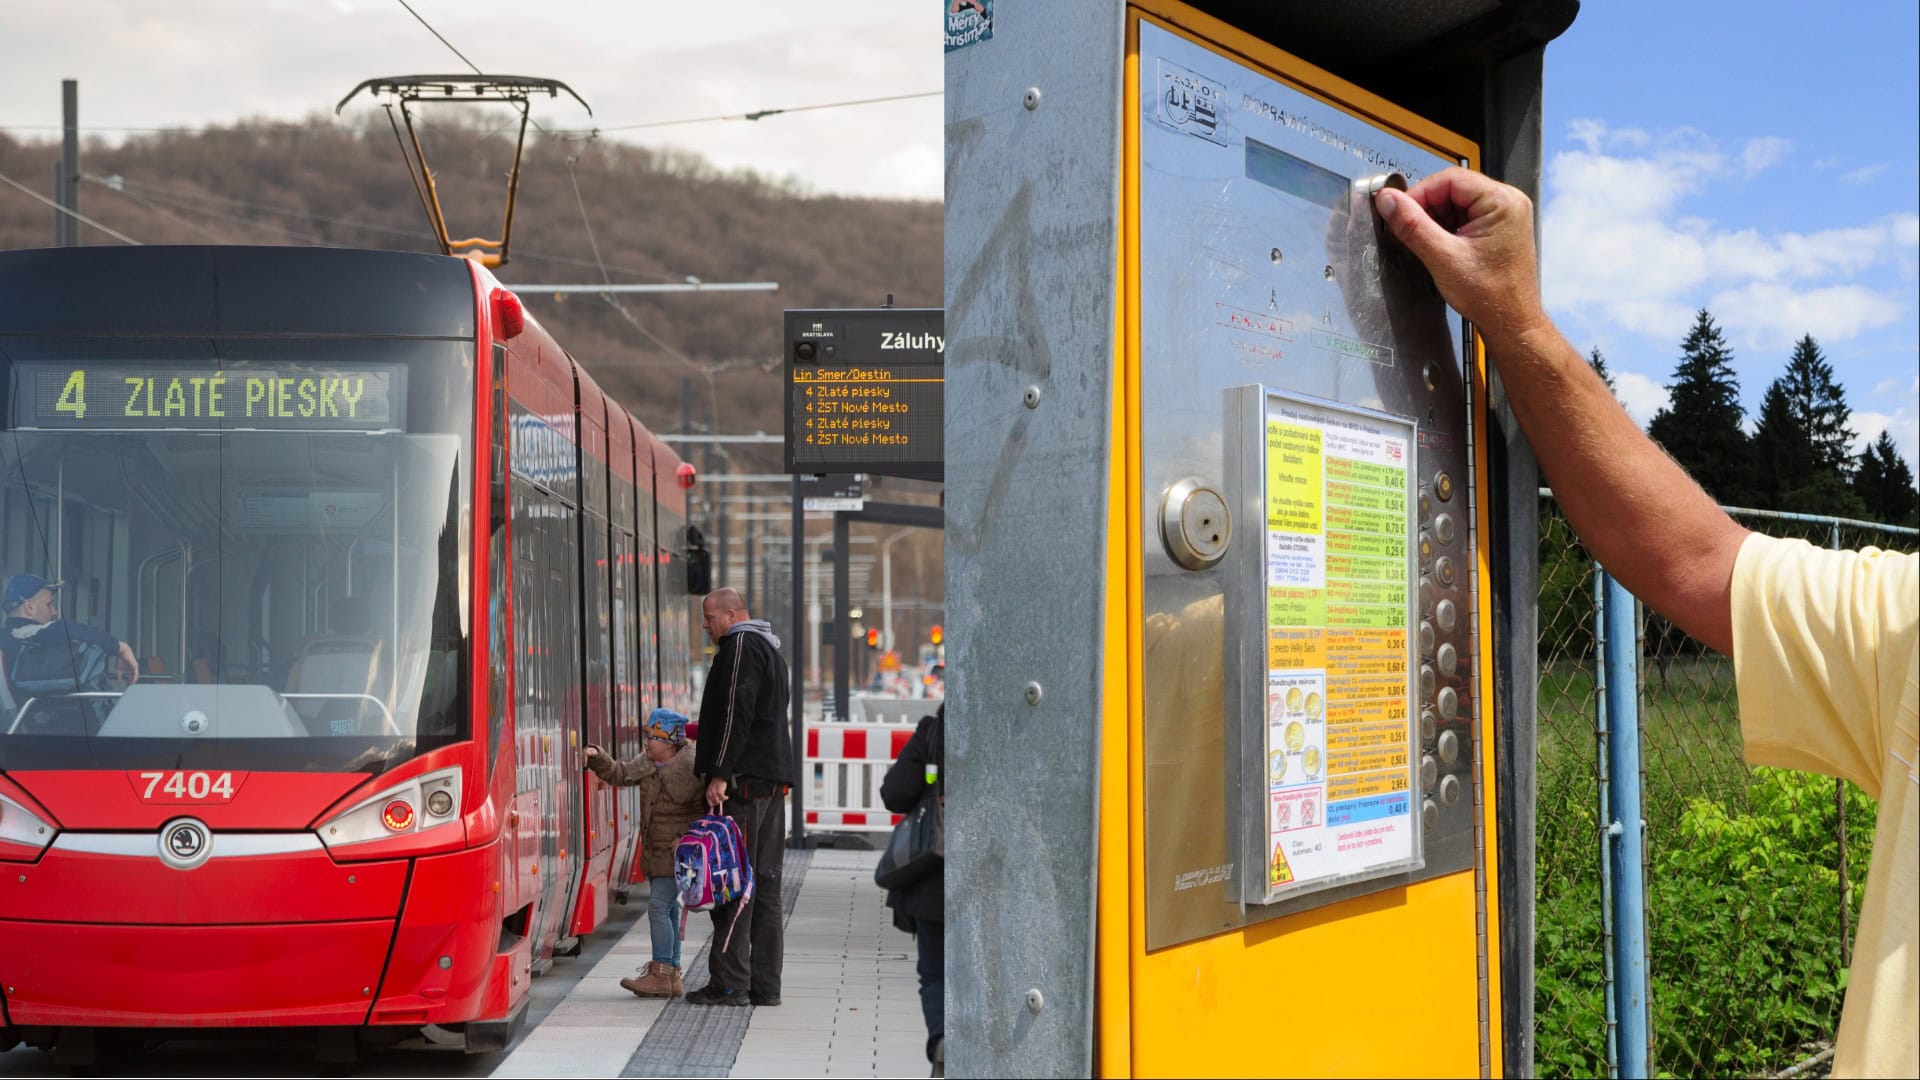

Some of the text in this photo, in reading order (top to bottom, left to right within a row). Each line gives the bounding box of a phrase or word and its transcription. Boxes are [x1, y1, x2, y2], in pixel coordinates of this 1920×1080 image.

[949, 13, 980, 31] Merry
[943, 15, 991, 46] hristmas
[881, 332, 945, 352] Záluhy
[793, 368, 891, 380] Lin Smer/Destin
[55, 370, 364, 418] 4 ZLATÉ PIESKY
[806, 385, 890, 398] 4 Zlaté piesky
[806, 399, 908, 413] 4 ŽST Nové Mesto
[806, 417, 890, 430] 4 Zlaté piesky
[806, 430, 908, 445] 4 ŽST Nové Mesto
[1387, 616, 1399, 628] 2,50
[1387, 640, 1400, 649] 0,30
[1388, 709, 1400, 720] 0,20
[140, 771, 234, 799] 7404
